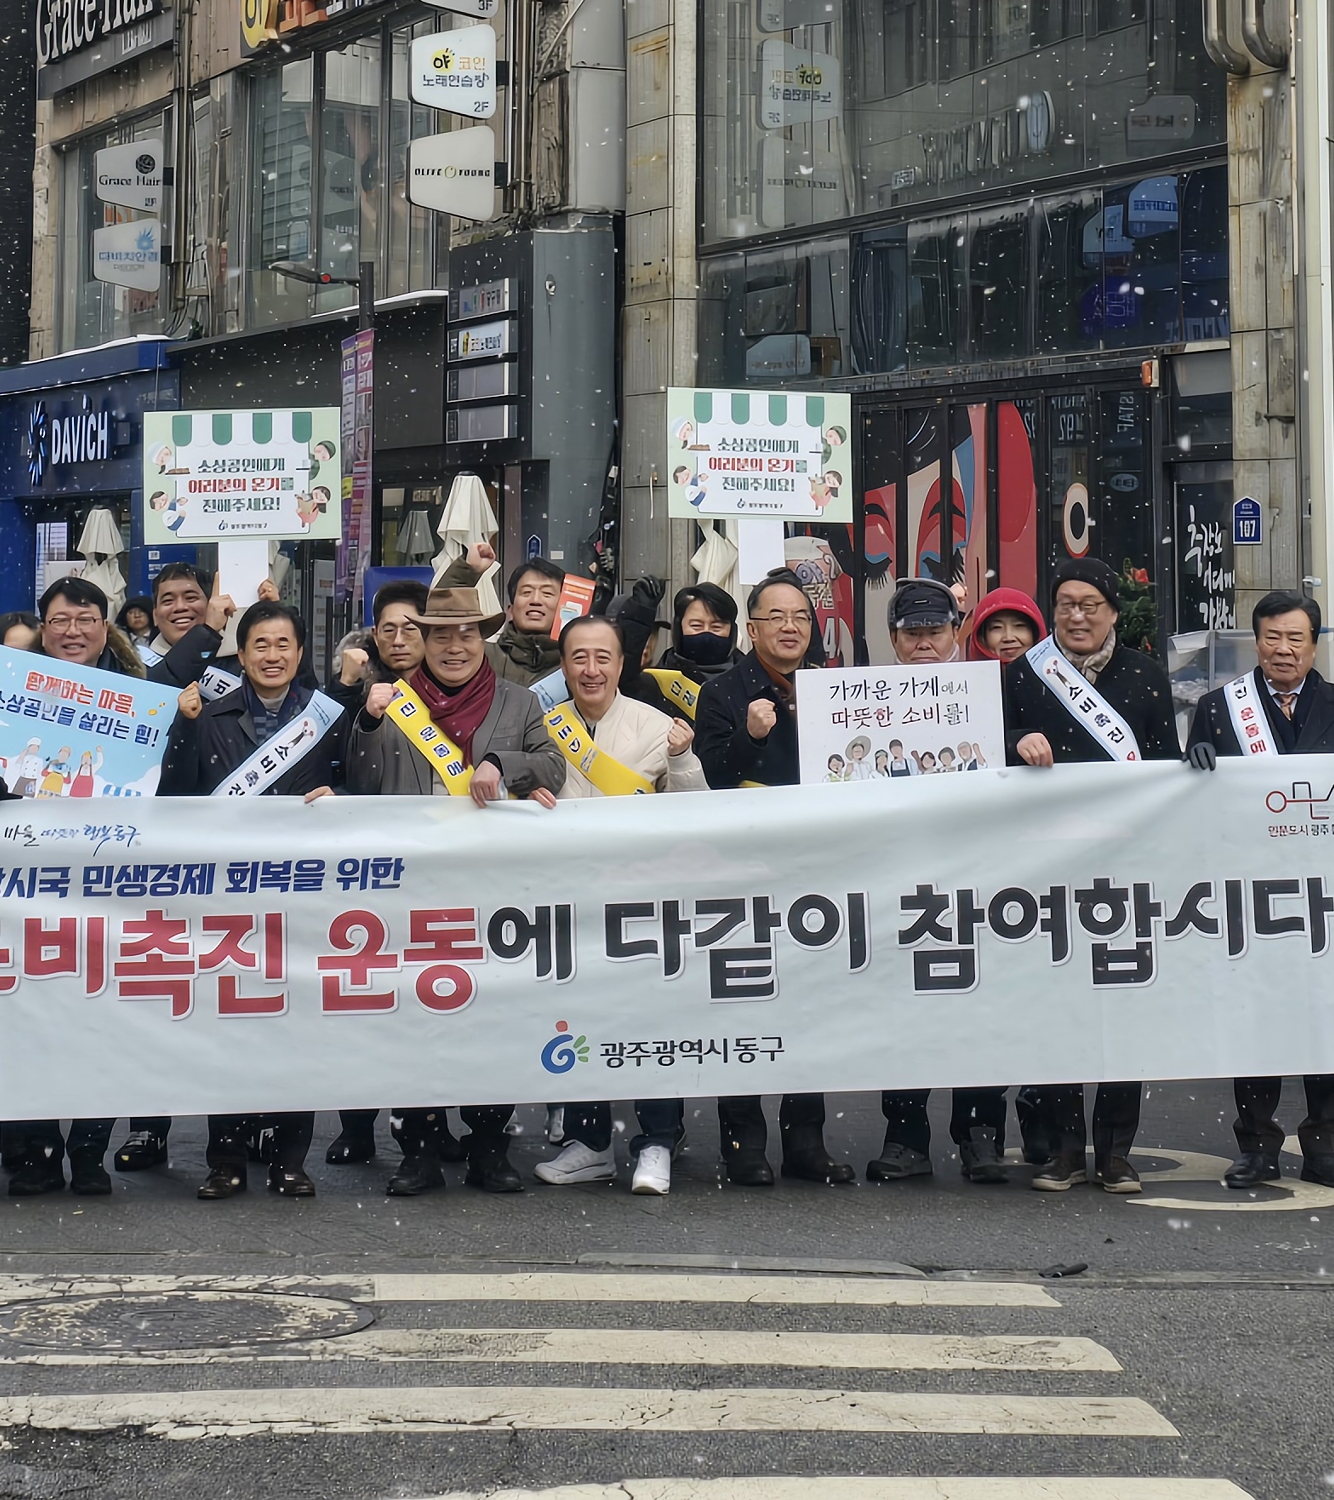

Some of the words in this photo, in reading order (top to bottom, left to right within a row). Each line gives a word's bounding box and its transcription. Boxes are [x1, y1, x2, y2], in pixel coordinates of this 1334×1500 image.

[478, 0, 494, 12] 3F
[458, 56, 487, 71] 코인
[474, 102, 490, 113] 2F
[99, 174, 132, 186] Grace
[136, 175, 161, 187] Hair
[51, 394, 109, 466] DAVICH
[25, 670, 95, 706] 함께하는
[829, 678, 892, 701] 가까운
[899, 675, 969, 699] 가게에서
[77, 710, 130, 741] 살리는
[134, 723, 160, 749] 힘!
[831, 705, 894, 730] 따뜻한
[81, 862, 216, 898] 민생경제
[225, 858, 327, 895] 회복을
[336, 856, 405, 891] 위한
[316, 896, 578, 1017] 운동에
[603, 888, 872, 1003] 다같이
